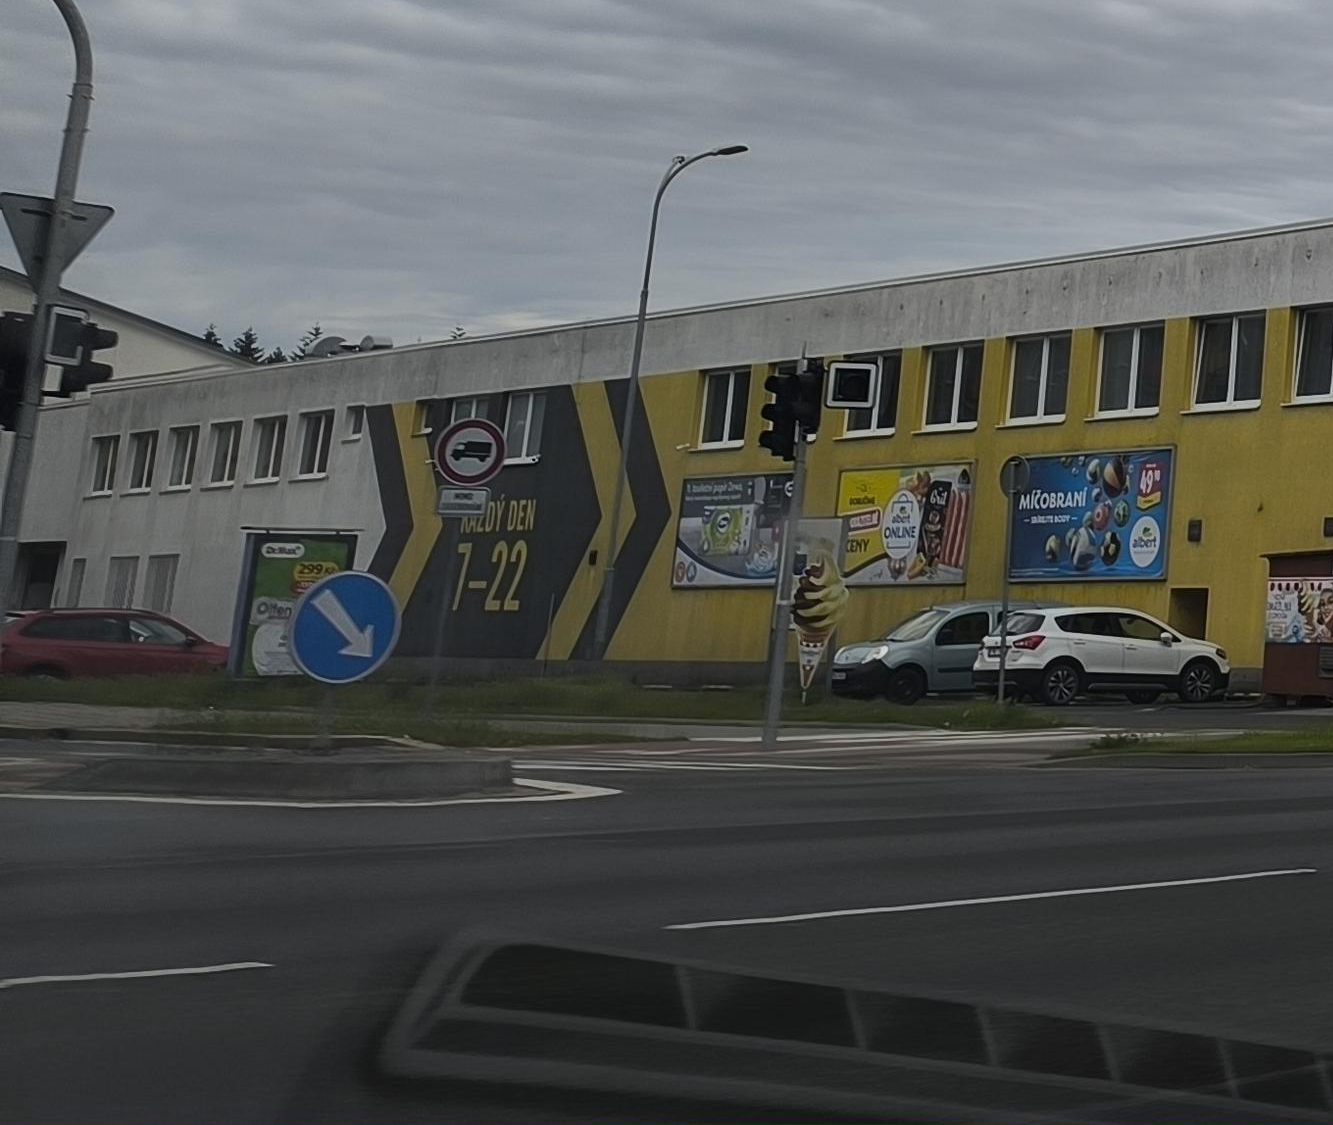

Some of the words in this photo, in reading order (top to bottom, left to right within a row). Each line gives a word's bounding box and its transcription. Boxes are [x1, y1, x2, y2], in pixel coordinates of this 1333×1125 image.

[1019, 487, 1088, 510] MÍČOBRANÍ
[507, 499, 537, 531] DEN
[884, 526, 916, 539] ONLINE
[1132, 537, 1158, 548] albert
[298, 563, 323, 574] 299
